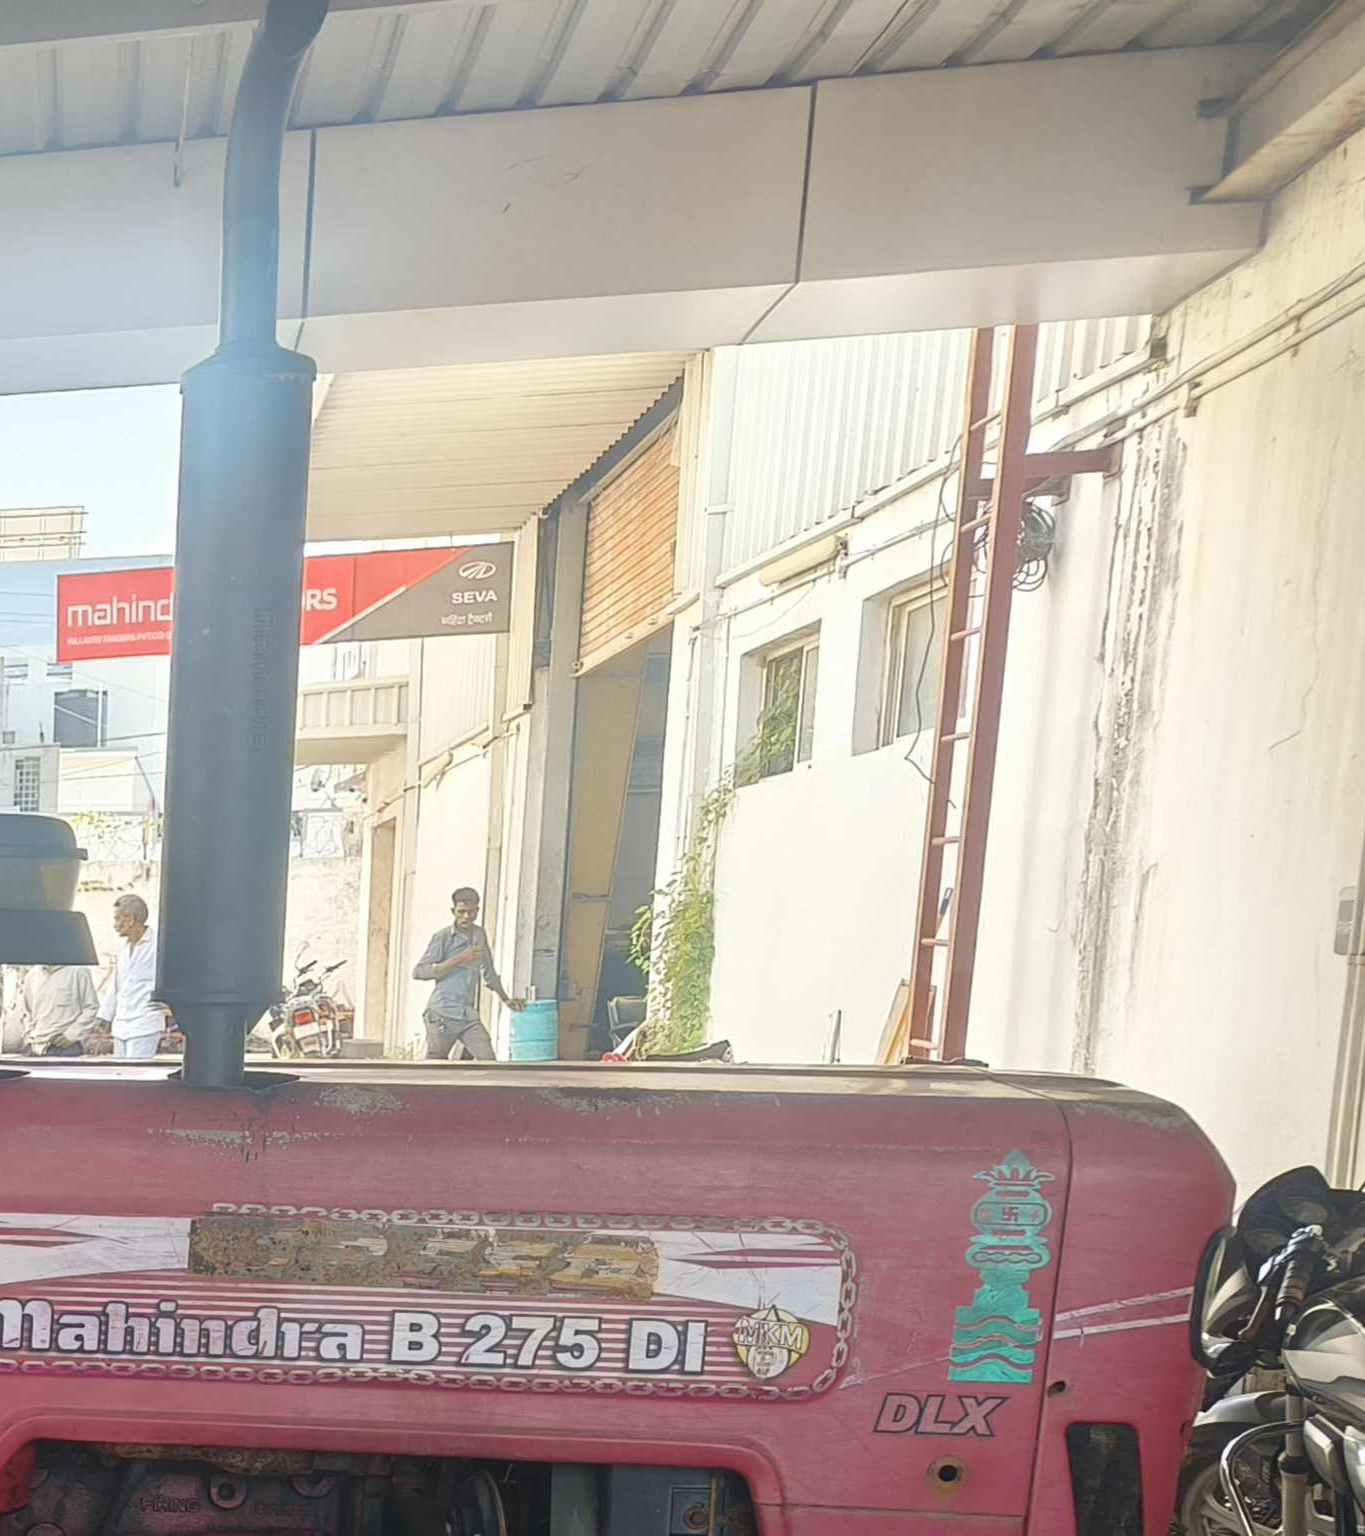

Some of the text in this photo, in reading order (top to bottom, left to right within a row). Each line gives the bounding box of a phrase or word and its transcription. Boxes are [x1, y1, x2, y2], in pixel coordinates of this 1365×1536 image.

[303, 587, 337, 611] RS
[452, 590, 497, 604] SEVA
[389, 1310, 443, 1363] B
[459, 1312, 603, 1370] 275
[626, 1317, 708, 1375] DI
[873, 1393, 1011, 1437] DLX
